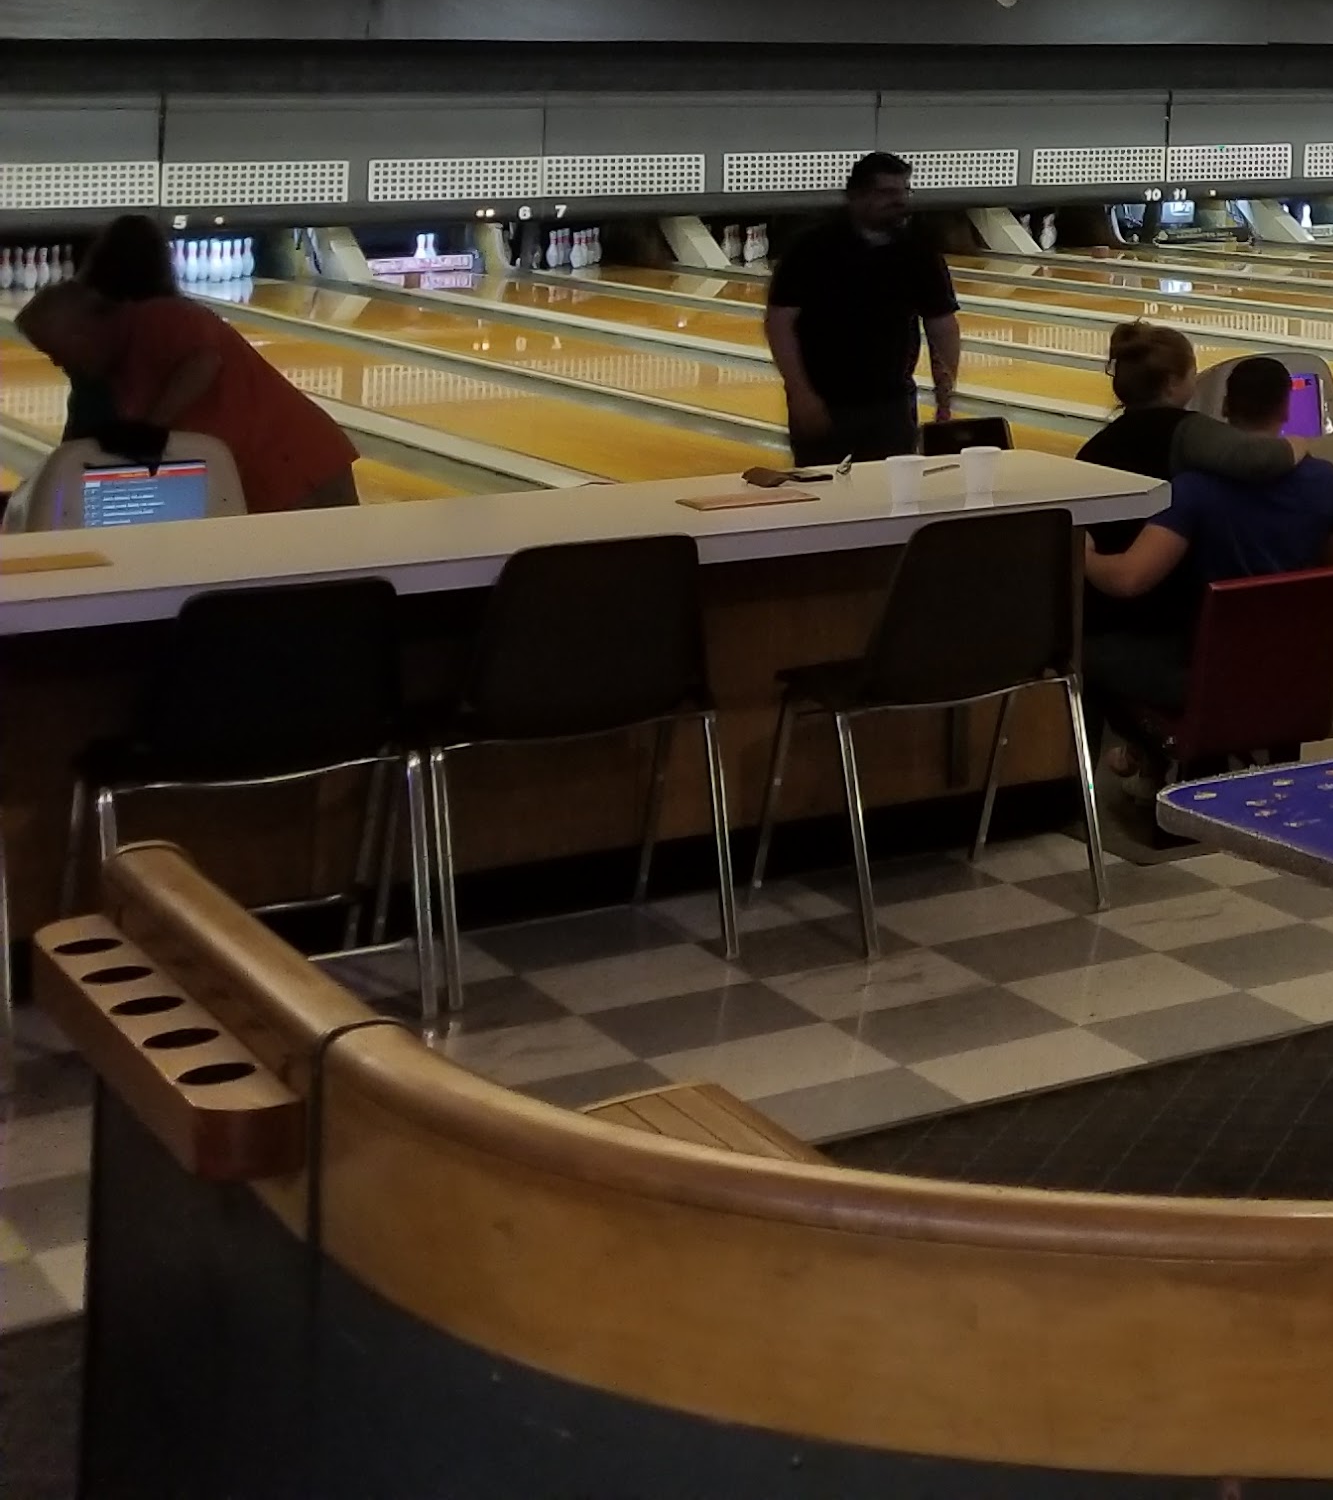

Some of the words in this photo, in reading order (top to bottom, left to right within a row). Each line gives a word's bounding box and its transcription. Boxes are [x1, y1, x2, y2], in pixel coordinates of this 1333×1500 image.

[1144, 188, 1162, 201] 10
[1173, 187, 1187, 200] 11
[518, 205, 531, 220] 6
[555, 204, 567, 218] 7
[172, 214, 188, 229] 5
